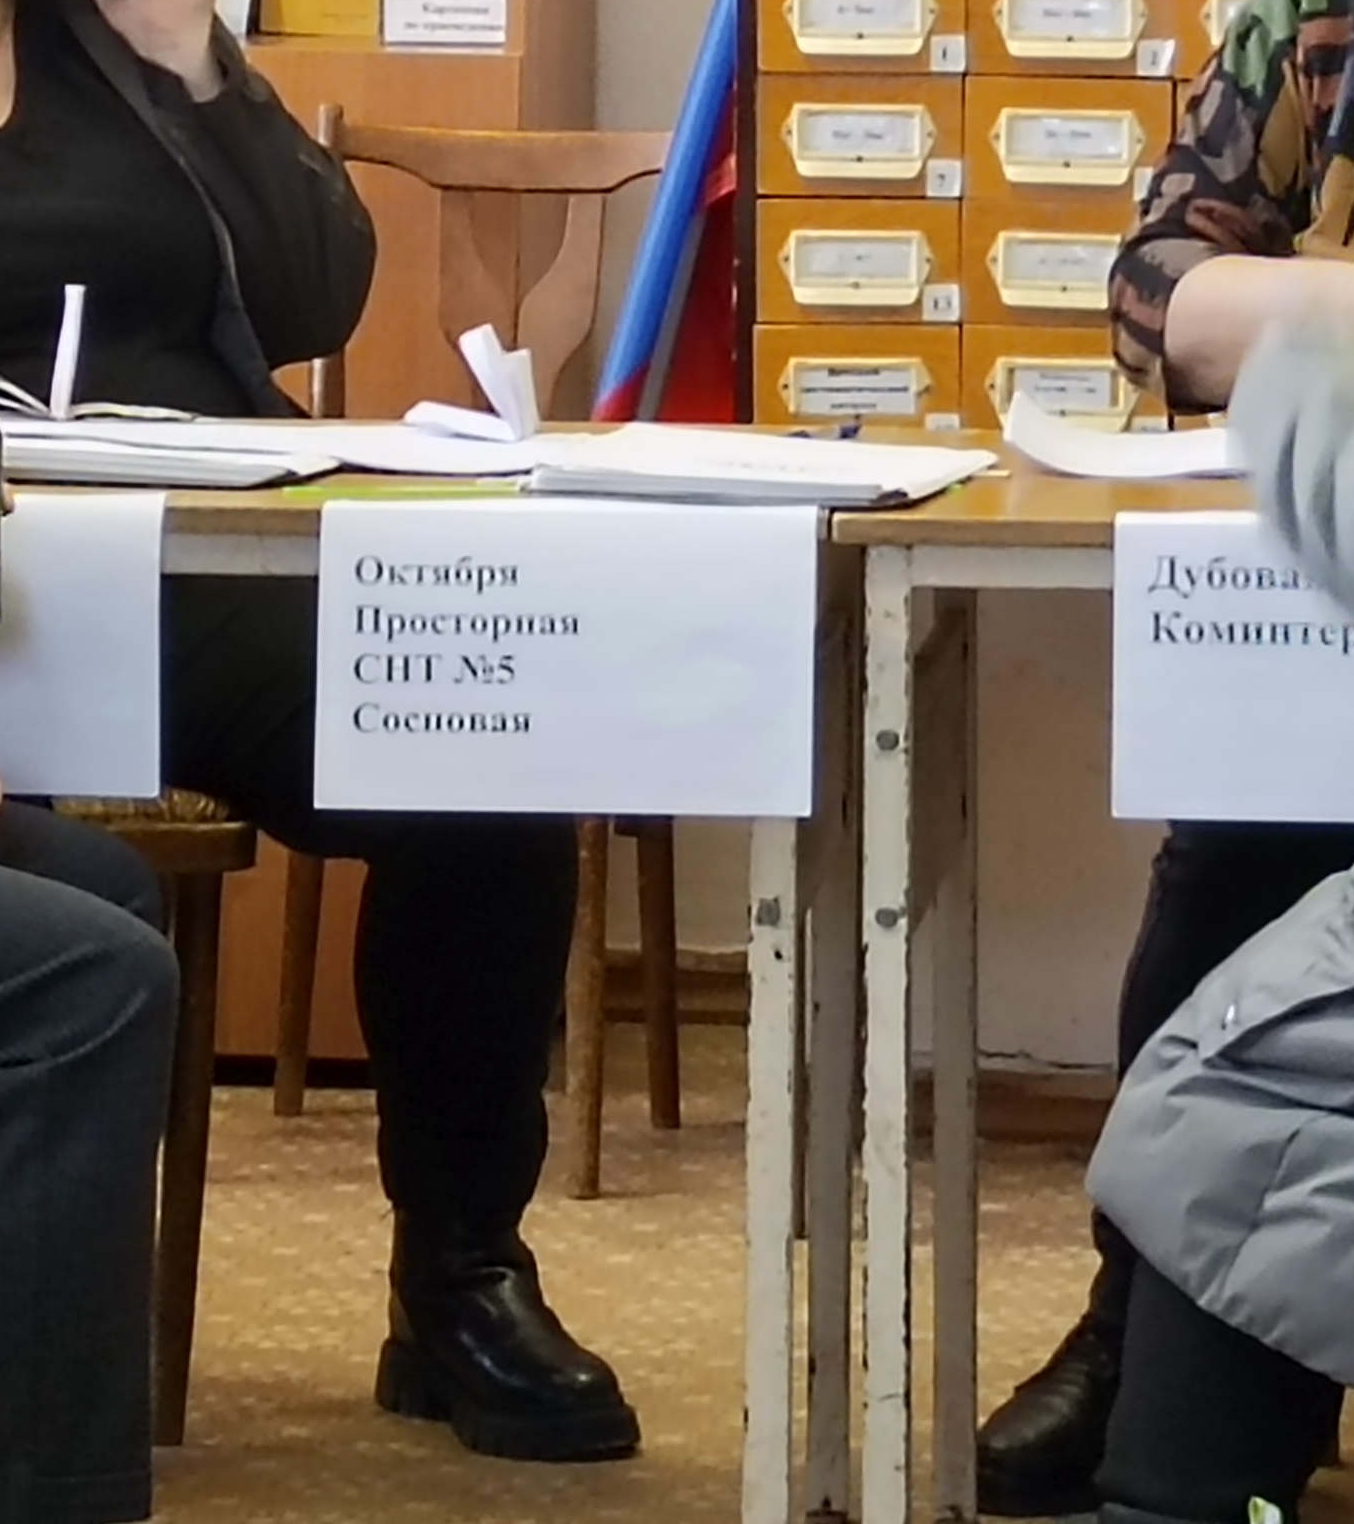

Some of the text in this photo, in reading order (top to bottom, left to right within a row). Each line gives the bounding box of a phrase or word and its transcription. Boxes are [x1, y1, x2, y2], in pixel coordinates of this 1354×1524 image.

[354, 554, 518, 595] Октября
[1148, 556, 1315, 599] Дубова
[354, 604, 580, 644] Просторная
[353, 652, 516, 685] СНТ №5
[353, 701, 531, 734] Сосновая
